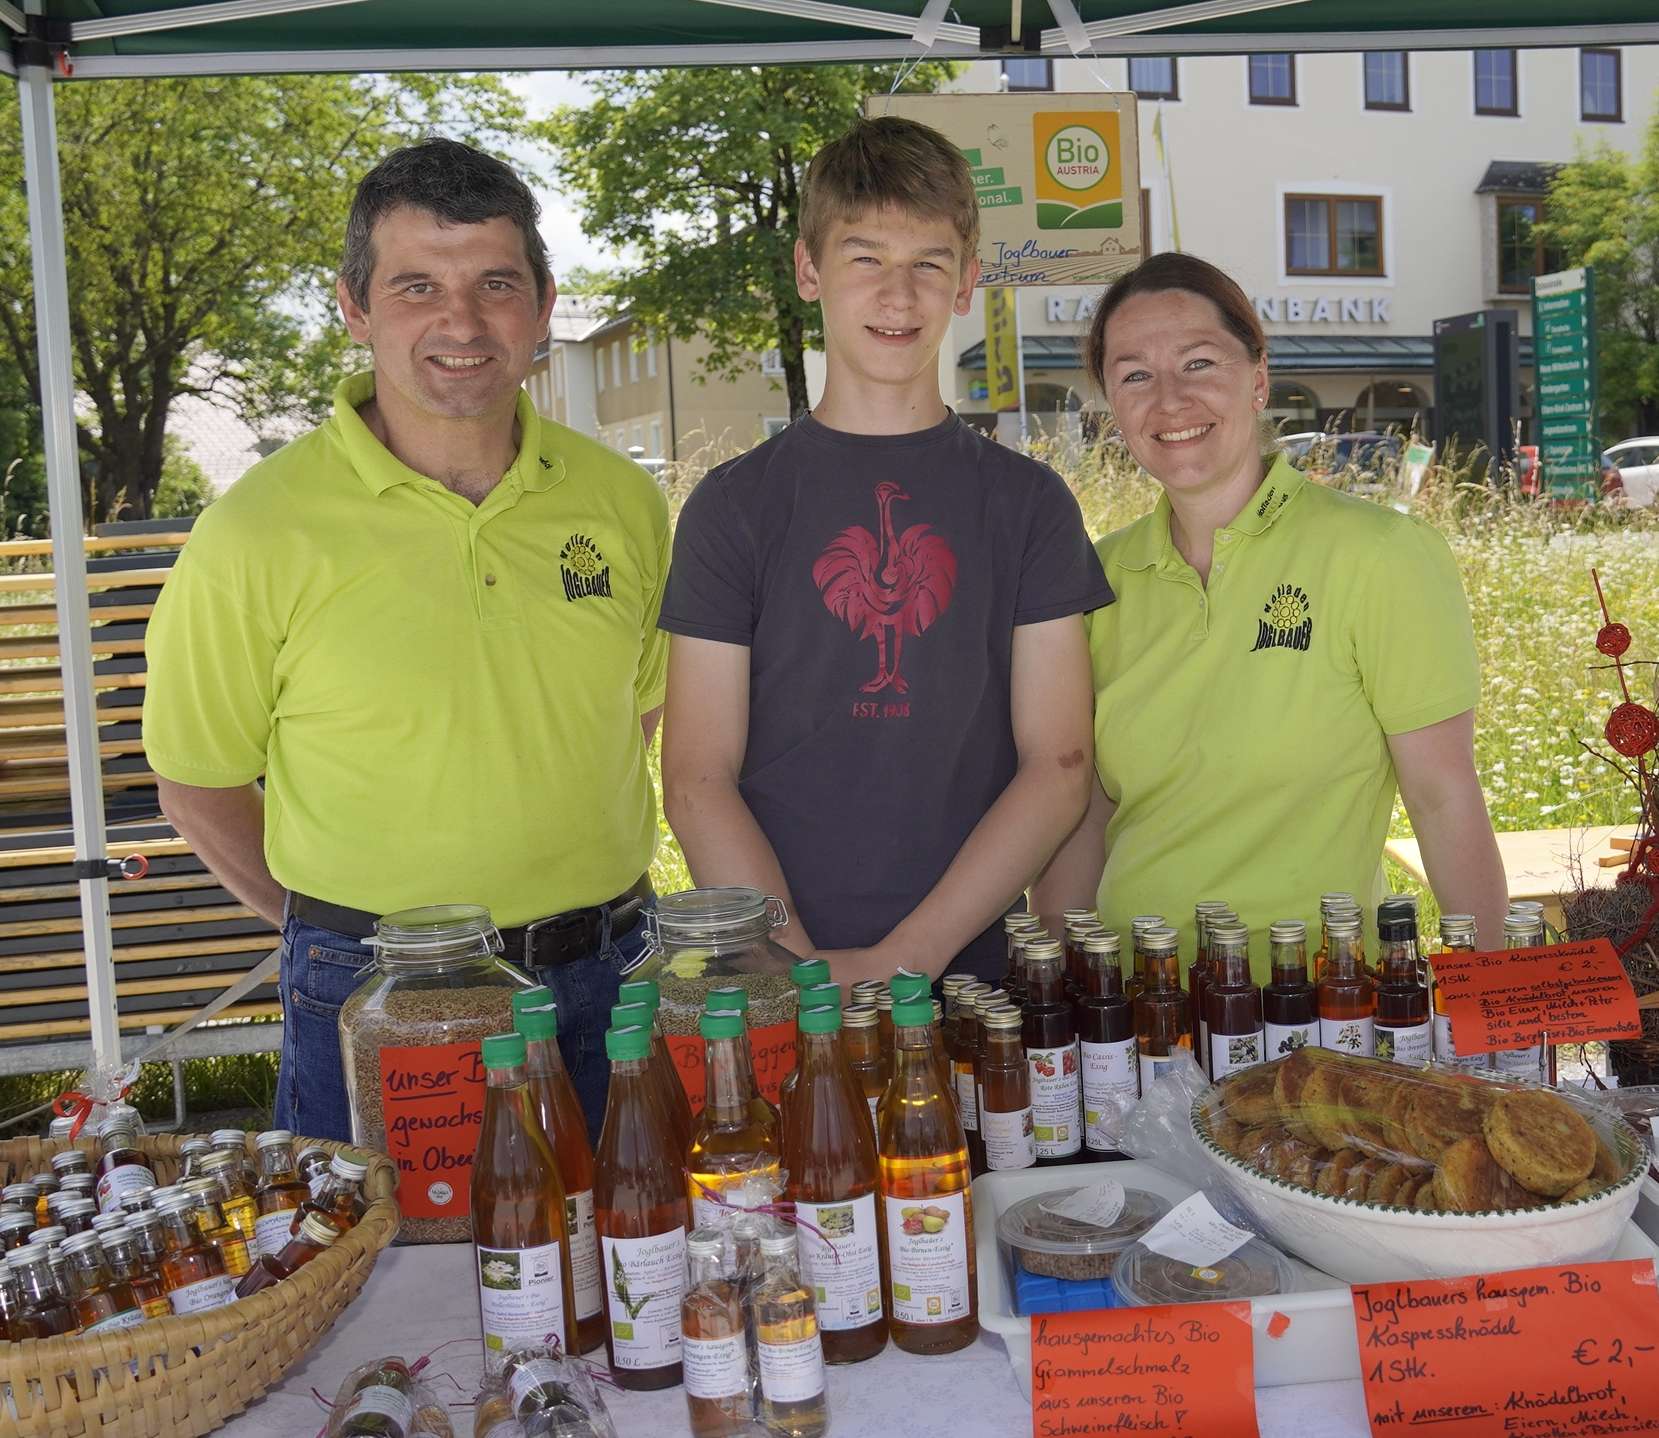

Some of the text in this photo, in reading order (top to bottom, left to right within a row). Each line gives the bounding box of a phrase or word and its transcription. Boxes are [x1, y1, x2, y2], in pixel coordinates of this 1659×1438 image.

[1057, 138, 1099, 164] Bio
[1056, 165, 1100, 176] AUSTRIA
[992, 240, 1080, 268] Joglbauer
[1475, 956, 1502, 967] Bio
[1558, 962, 1573, 972] €
[1479, 998, 1501, 1008] Bio
[1481, 1008, 1506, 1019] Bio
[1517, 1016, 1542, 1026] und
[1486, 1034, 1509, 1045] Bio
[390, 1102, 483, 1148] gewachs
[1353, 1270, 1602, 1325] Joglbauers hausgem. Bio
[1034, 1318, 1221, 1355] hausgemachtes Bio
[1365, 1315, 1522, 1349] Kaspressknödel
[1571, 1338, 1656, 1368] € 2,-
[1035, 1354, 1191, 1391] Grammelschmalz
[1368, 1360, 1385, 1383] 1
[1036, 1396, 1070, 1411] aus
[1152, 1385, 1185, 1406] Bio
[1373, 1400, 1405, 1425] mit
[1586, 1419, 1659, 1435] Petersili
